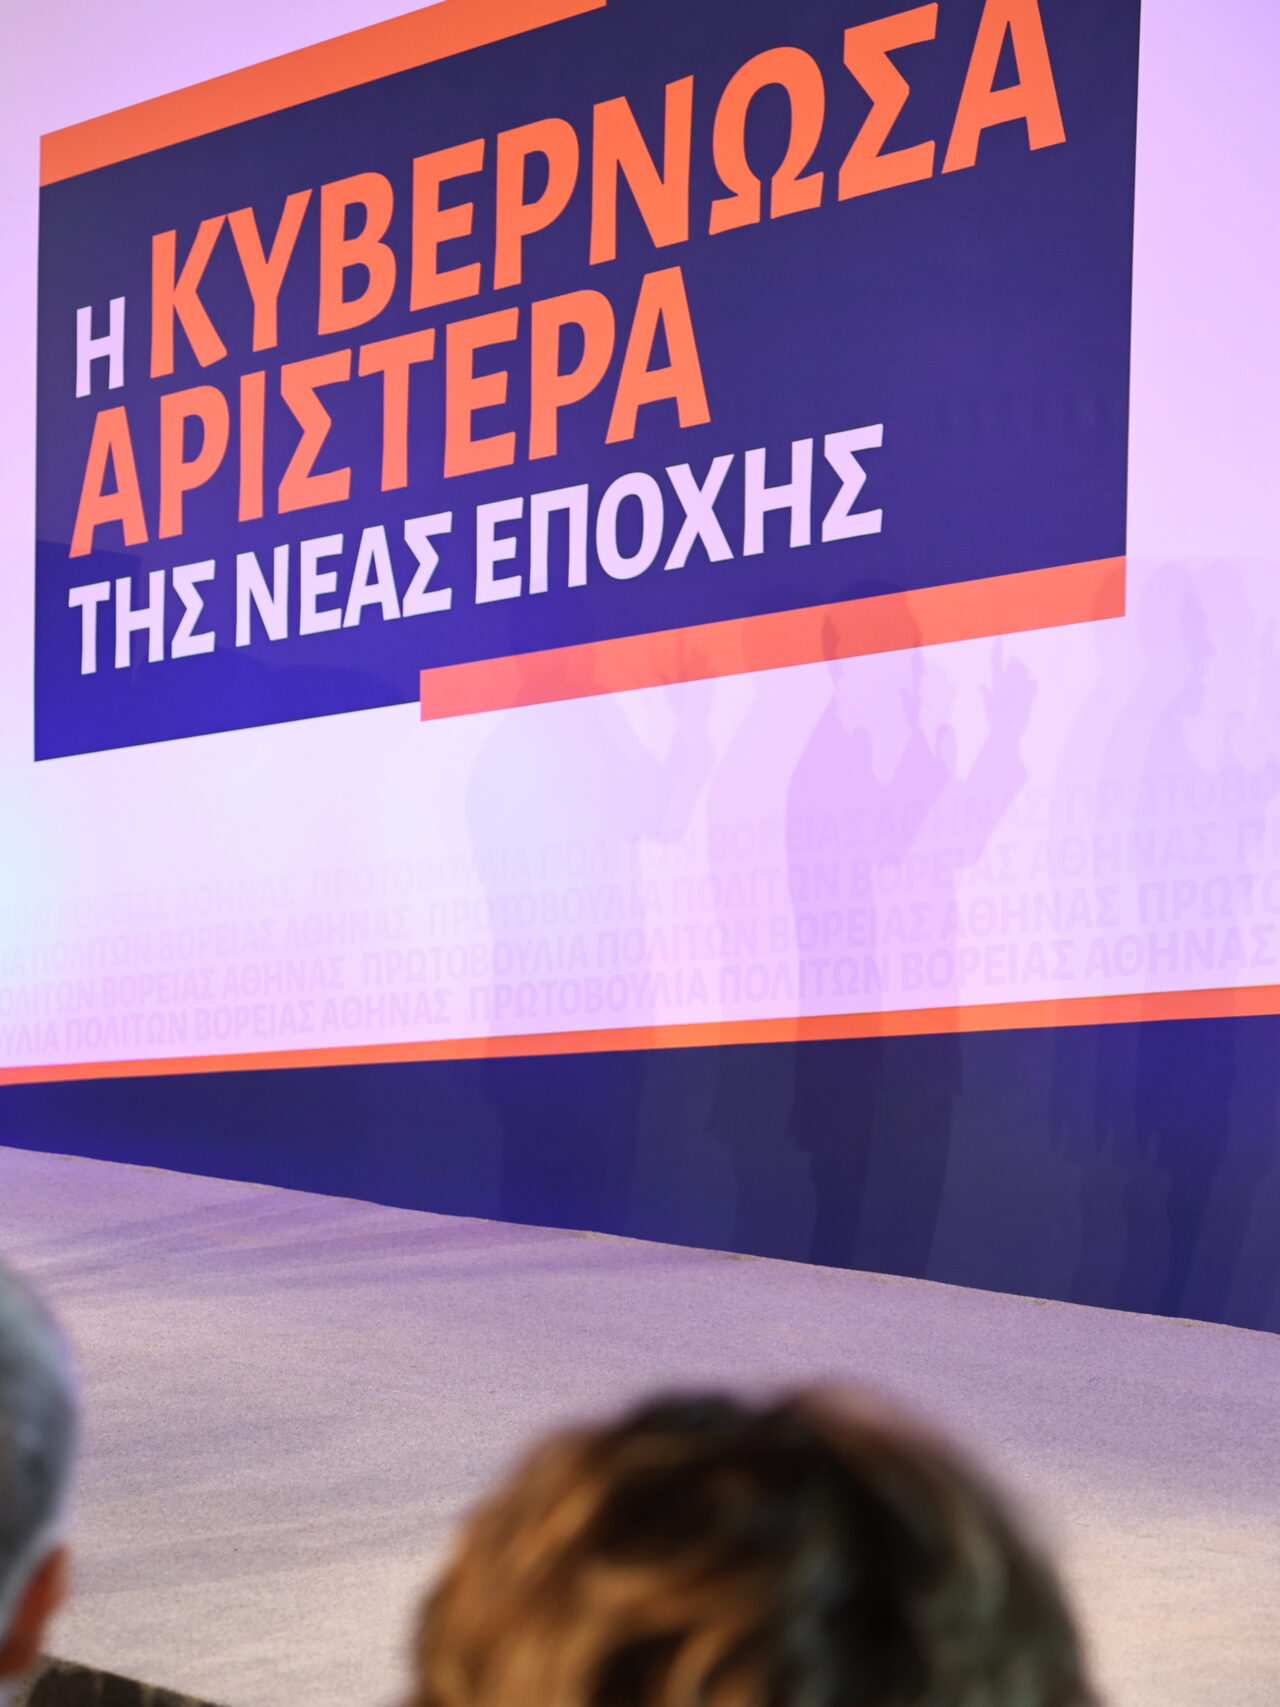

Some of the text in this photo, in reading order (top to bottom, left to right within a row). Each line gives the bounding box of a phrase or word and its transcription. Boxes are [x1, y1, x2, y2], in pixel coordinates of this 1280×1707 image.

[75, 0, 1067, 399] Η ΚΥΒΕΡΝΩΣΑ
[69, 265, 712, 559] ΑΡΙΣΤΕΡΑ
[68, 423, 884, 675] ΤΗΣ ΝΕΑΣ ΕΠΟΧΗΣ
[32, 933, 151, 974] ΠΟΛΙΤΩΝ
[158, 919, 276, 962] ΒΟΡΕΙΑΣ
[282, 904, 410, 949] ΑΘΗΝΑΣ
[428, 880, 662, 936] ΠΡΩΤΟΒΟΥΛΙΑ
[672, 860, 840, 915] ΠΟΛΙΤΩΝ
[849, 842, 1020, 898] ΒΟΡΕΙΑΣ
[1030, 822, 1216, 881] ΑΘΗΝΑΣ
[176, 873, 295, 919] ΑΘΗΝΑΣ
[710, 809, 864, 862] ΒΟΡΕΙΑΣ
[65, 1010, 187, 1050] ΠΟΛΙΤΩΝ
[194, 999, 315, 1042] ΒΟΡΕΙΑΣ
[320, 988, 452, 1032] ΑΘΗΝΑΣ
[471, 968, 709, 1022] ΠΡΩΤΟΒΟΥΛΙΑ
[720, 953, 890, 1004] ΠΟΛΙΤΩΝ
[902, 939, 1074, 991] ΒΟΡΕΙΑΣ
[1084, 924, 1276, 978] ΑΘΗΝΑΣ
[102, 966, 217, 1008] ΒΟΡΕΙΑΣ
[222, 954, 345, 998] ΑΘΗΝΑΣ
[362, 932, 589, 987] ΠΡΩΤΟΒΟΥΛΙΑ
[596, 918, 758, 968] ΠΟΛΙΤΩΝ
[770, 901, 932, 954] ΒΟΡΕΙΑΣ
[939, 884, 1120, 940] ΑΘΗΝΑΣ
